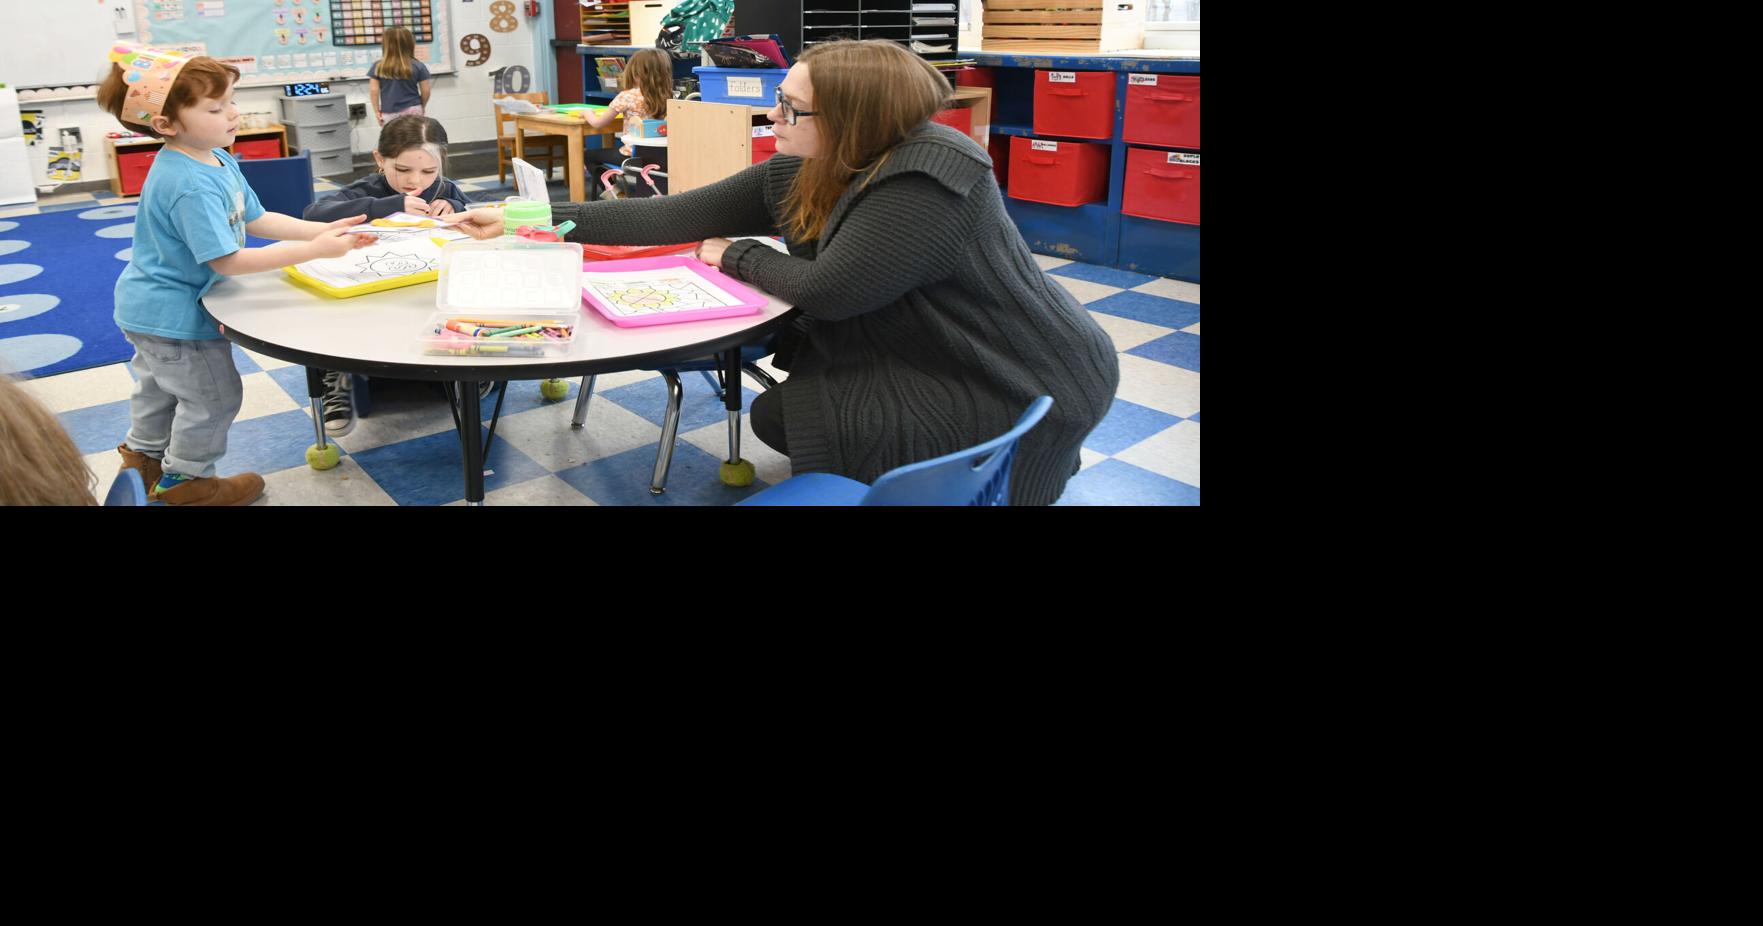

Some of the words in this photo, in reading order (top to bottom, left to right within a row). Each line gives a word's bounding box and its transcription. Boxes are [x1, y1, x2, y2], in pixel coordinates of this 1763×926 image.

[489, 0, 519, 33] 8
[460, 33, 491, 67] 9
[489, 65, 531, 95] 10
